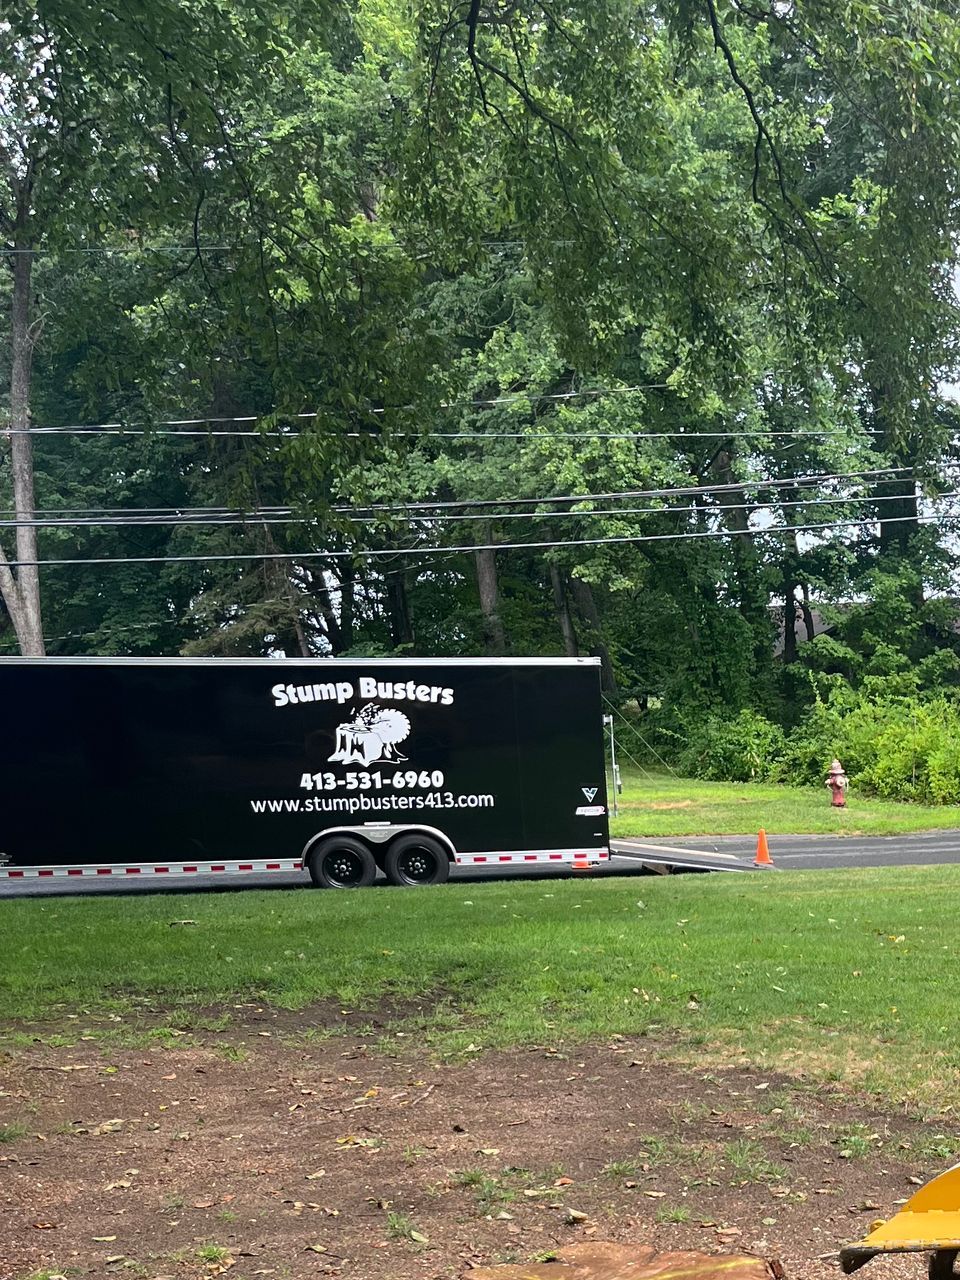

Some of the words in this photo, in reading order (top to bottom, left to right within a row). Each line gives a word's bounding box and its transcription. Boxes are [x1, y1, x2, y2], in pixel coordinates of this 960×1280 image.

[272, 682, 354, 707] Stump
[359, 677, 454, 705] Busters
[300, 770, 444, 790] 413-531-6960
[251, 792, 494, 814] www.stumpbusters413.com
